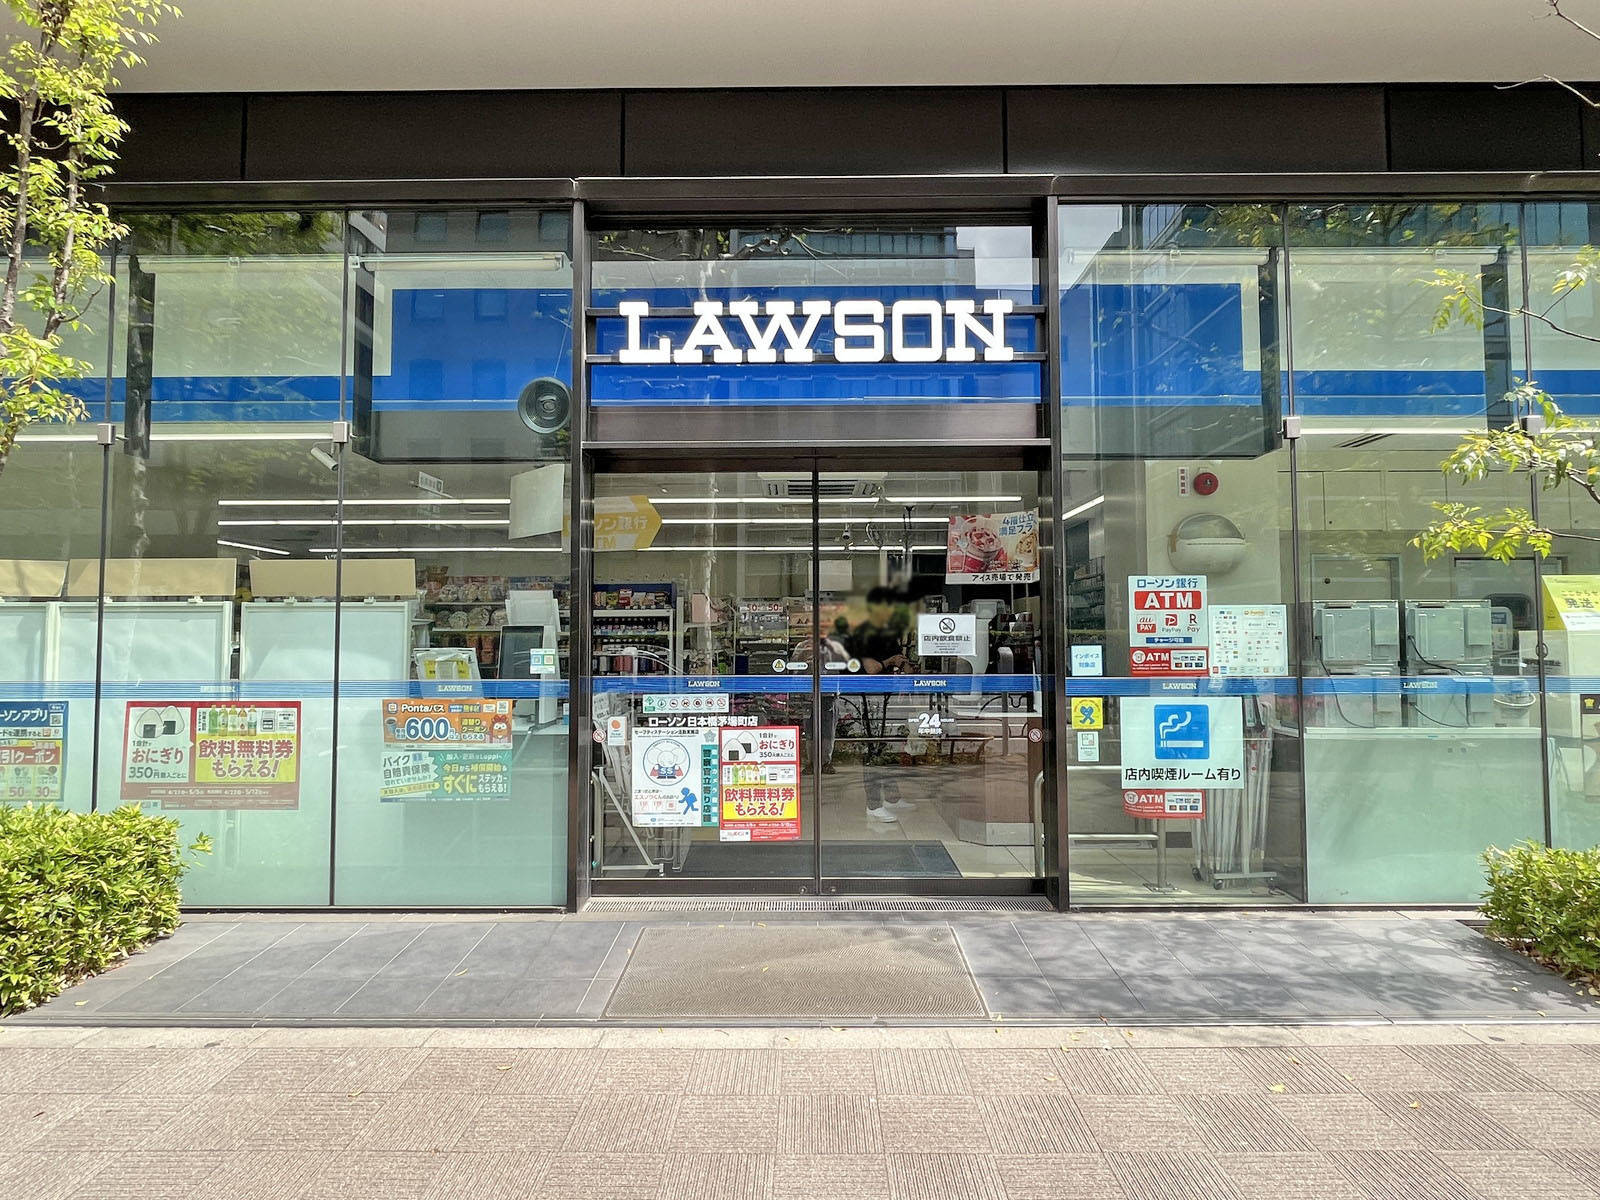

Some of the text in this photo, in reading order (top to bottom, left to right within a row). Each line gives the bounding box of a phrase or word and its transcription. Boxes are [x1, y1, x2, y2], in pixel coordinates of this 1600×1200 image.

[619, 299, 1014, 364] LAWSON
[1137, 578, 1198, 589] ローソン銀行
[1144, 592, 1193, 609] ATM
[1146, 653, 1170, 661] ATM
[1163, 682, 1197, 690] LAWSON
[401, 704, 445, 713] Pontaパス
[919, 713, 940, 728] 24
[405, 717, 450, 739] 600
[198, 739, 293, 759] 飲料無料券
[760, 740, 795, 750] おにぎり
[132, 747, 184, 764] おにぎり
[383, 755, 410, 768] バイク
[212, 759, 279, 778] もらえる!
[1125, 768, 1241, 781] 店内喫煙ルーム有り
[443, 774, 478, 794] すぐに
[478, 774, 508, 783] ステッカー
[478, 783, 507, 793] もらえる!
[725, 787, 795, 802] 飲料無料券
[1139, 795, 1164, 804] ATM
[735, 803, 785, 816] もらえる!
